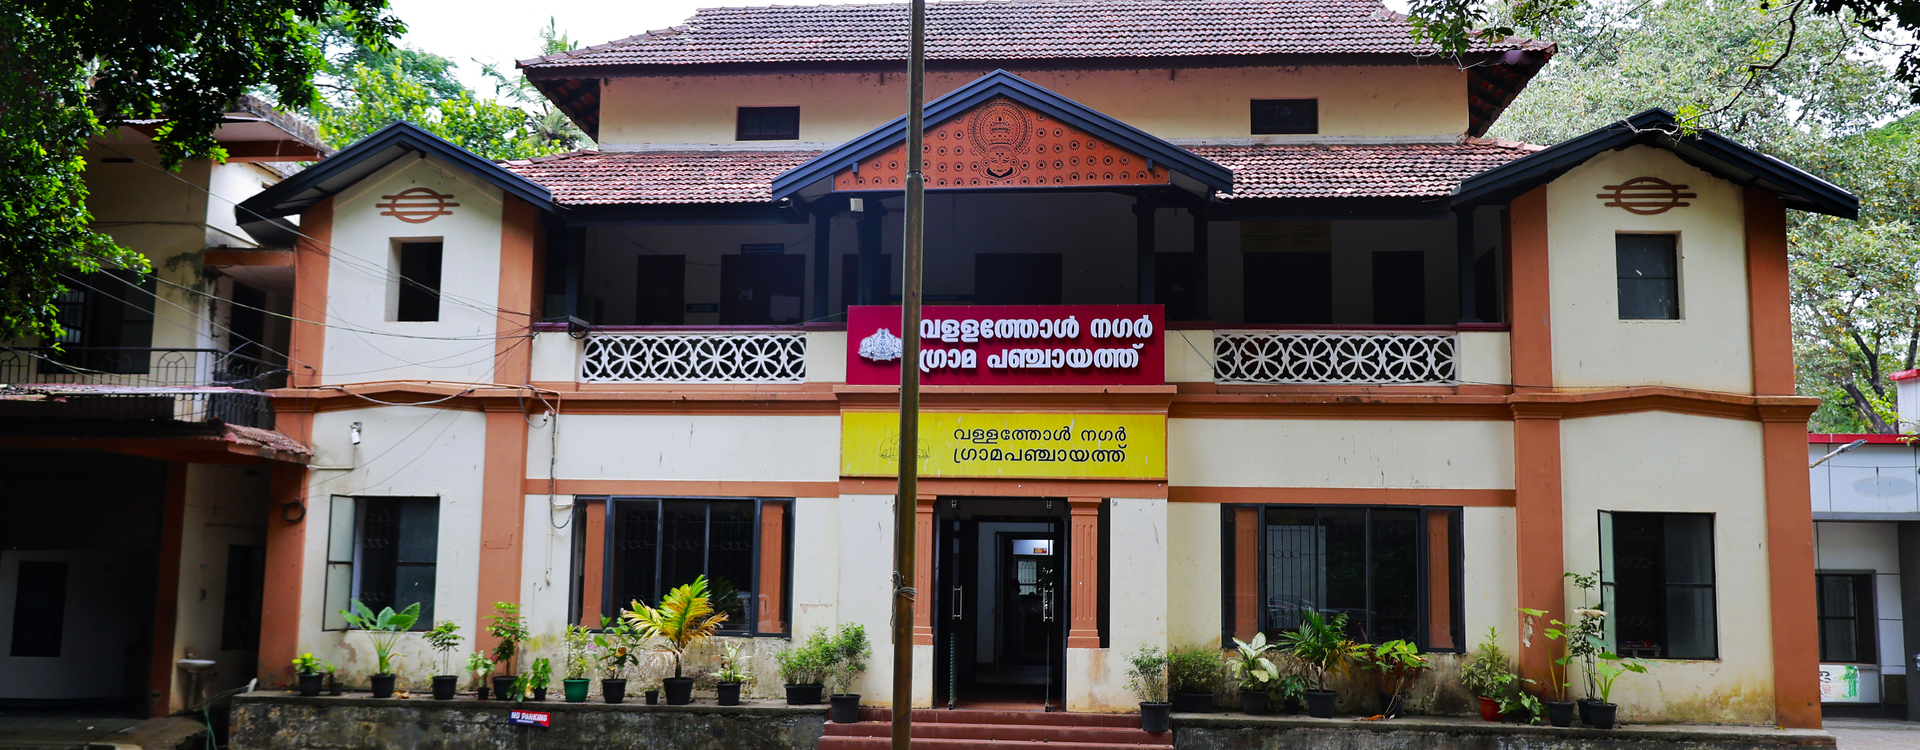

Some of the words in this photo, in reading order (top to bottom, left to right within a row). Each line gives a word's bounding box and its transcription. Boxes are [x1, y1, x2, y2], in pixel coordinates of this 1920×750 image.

[1090, 314, 1153, 338] നഗർ
[919, 348, 977, 373] ഗ്രാമ
[986, 342, 1144, 369] പഞ്ചായത്ത്
[954, 426, 1071, 445] വള്ളത്തോൾ
[1080, 426, 1127, 442] നഗർ
[511, 711, 520, 719] NO
[521, 712, 548, 722] PARKING
